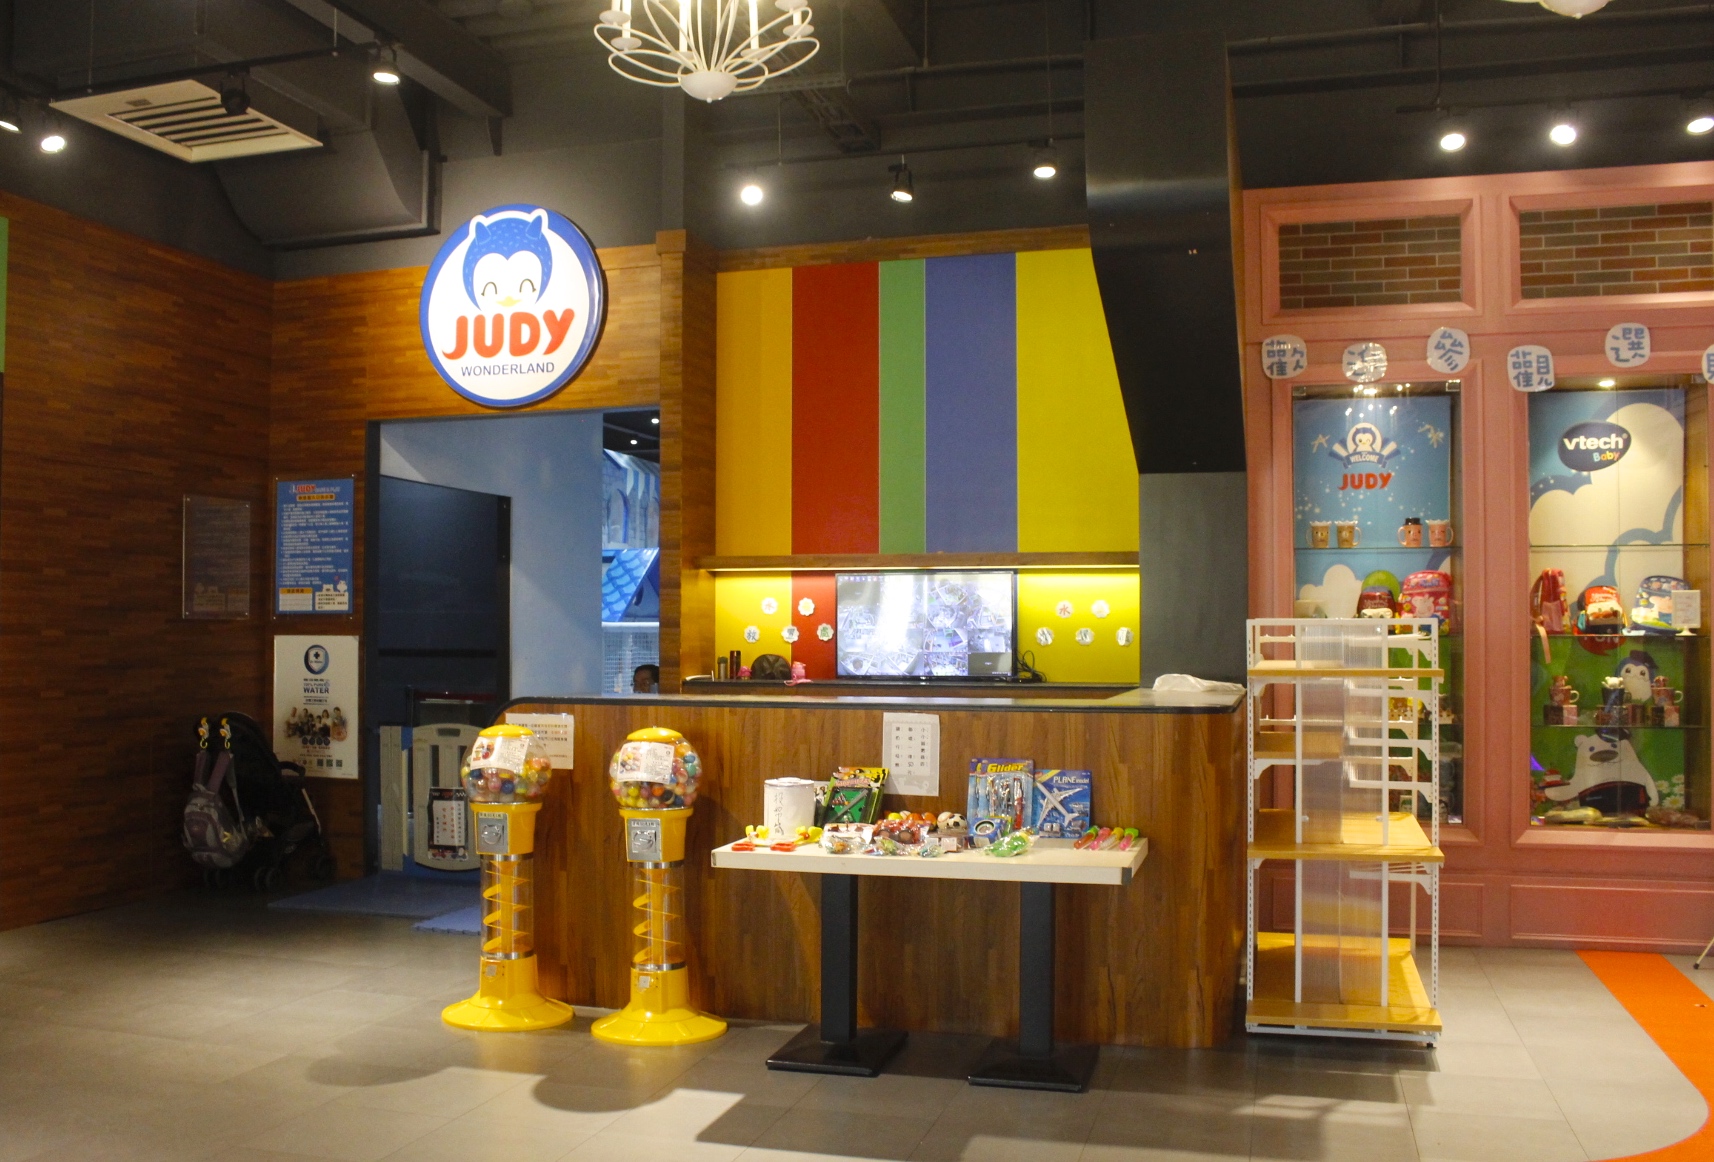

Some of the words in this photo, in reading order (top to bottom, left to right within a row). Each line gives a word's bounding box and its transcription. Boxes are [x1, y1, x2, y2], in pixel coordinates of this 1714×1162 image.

[442, 308, 575, 360] JUDY
[1435, 330, 1464, 371] 參
[1609, 327, 1646, 362] 選
[461, 362, 555, 377] WONDERLAND
[1563, 433, 1623, 450] vtech
[1349, 453, 1379, 463] WELCOME
[1592, 451, 1620, 462] Baby
[1337, 472, 1392, 490] JUDY
[987, 763, 1024, 773] Glider
[1053, 776, 1076, 784] PLANE
